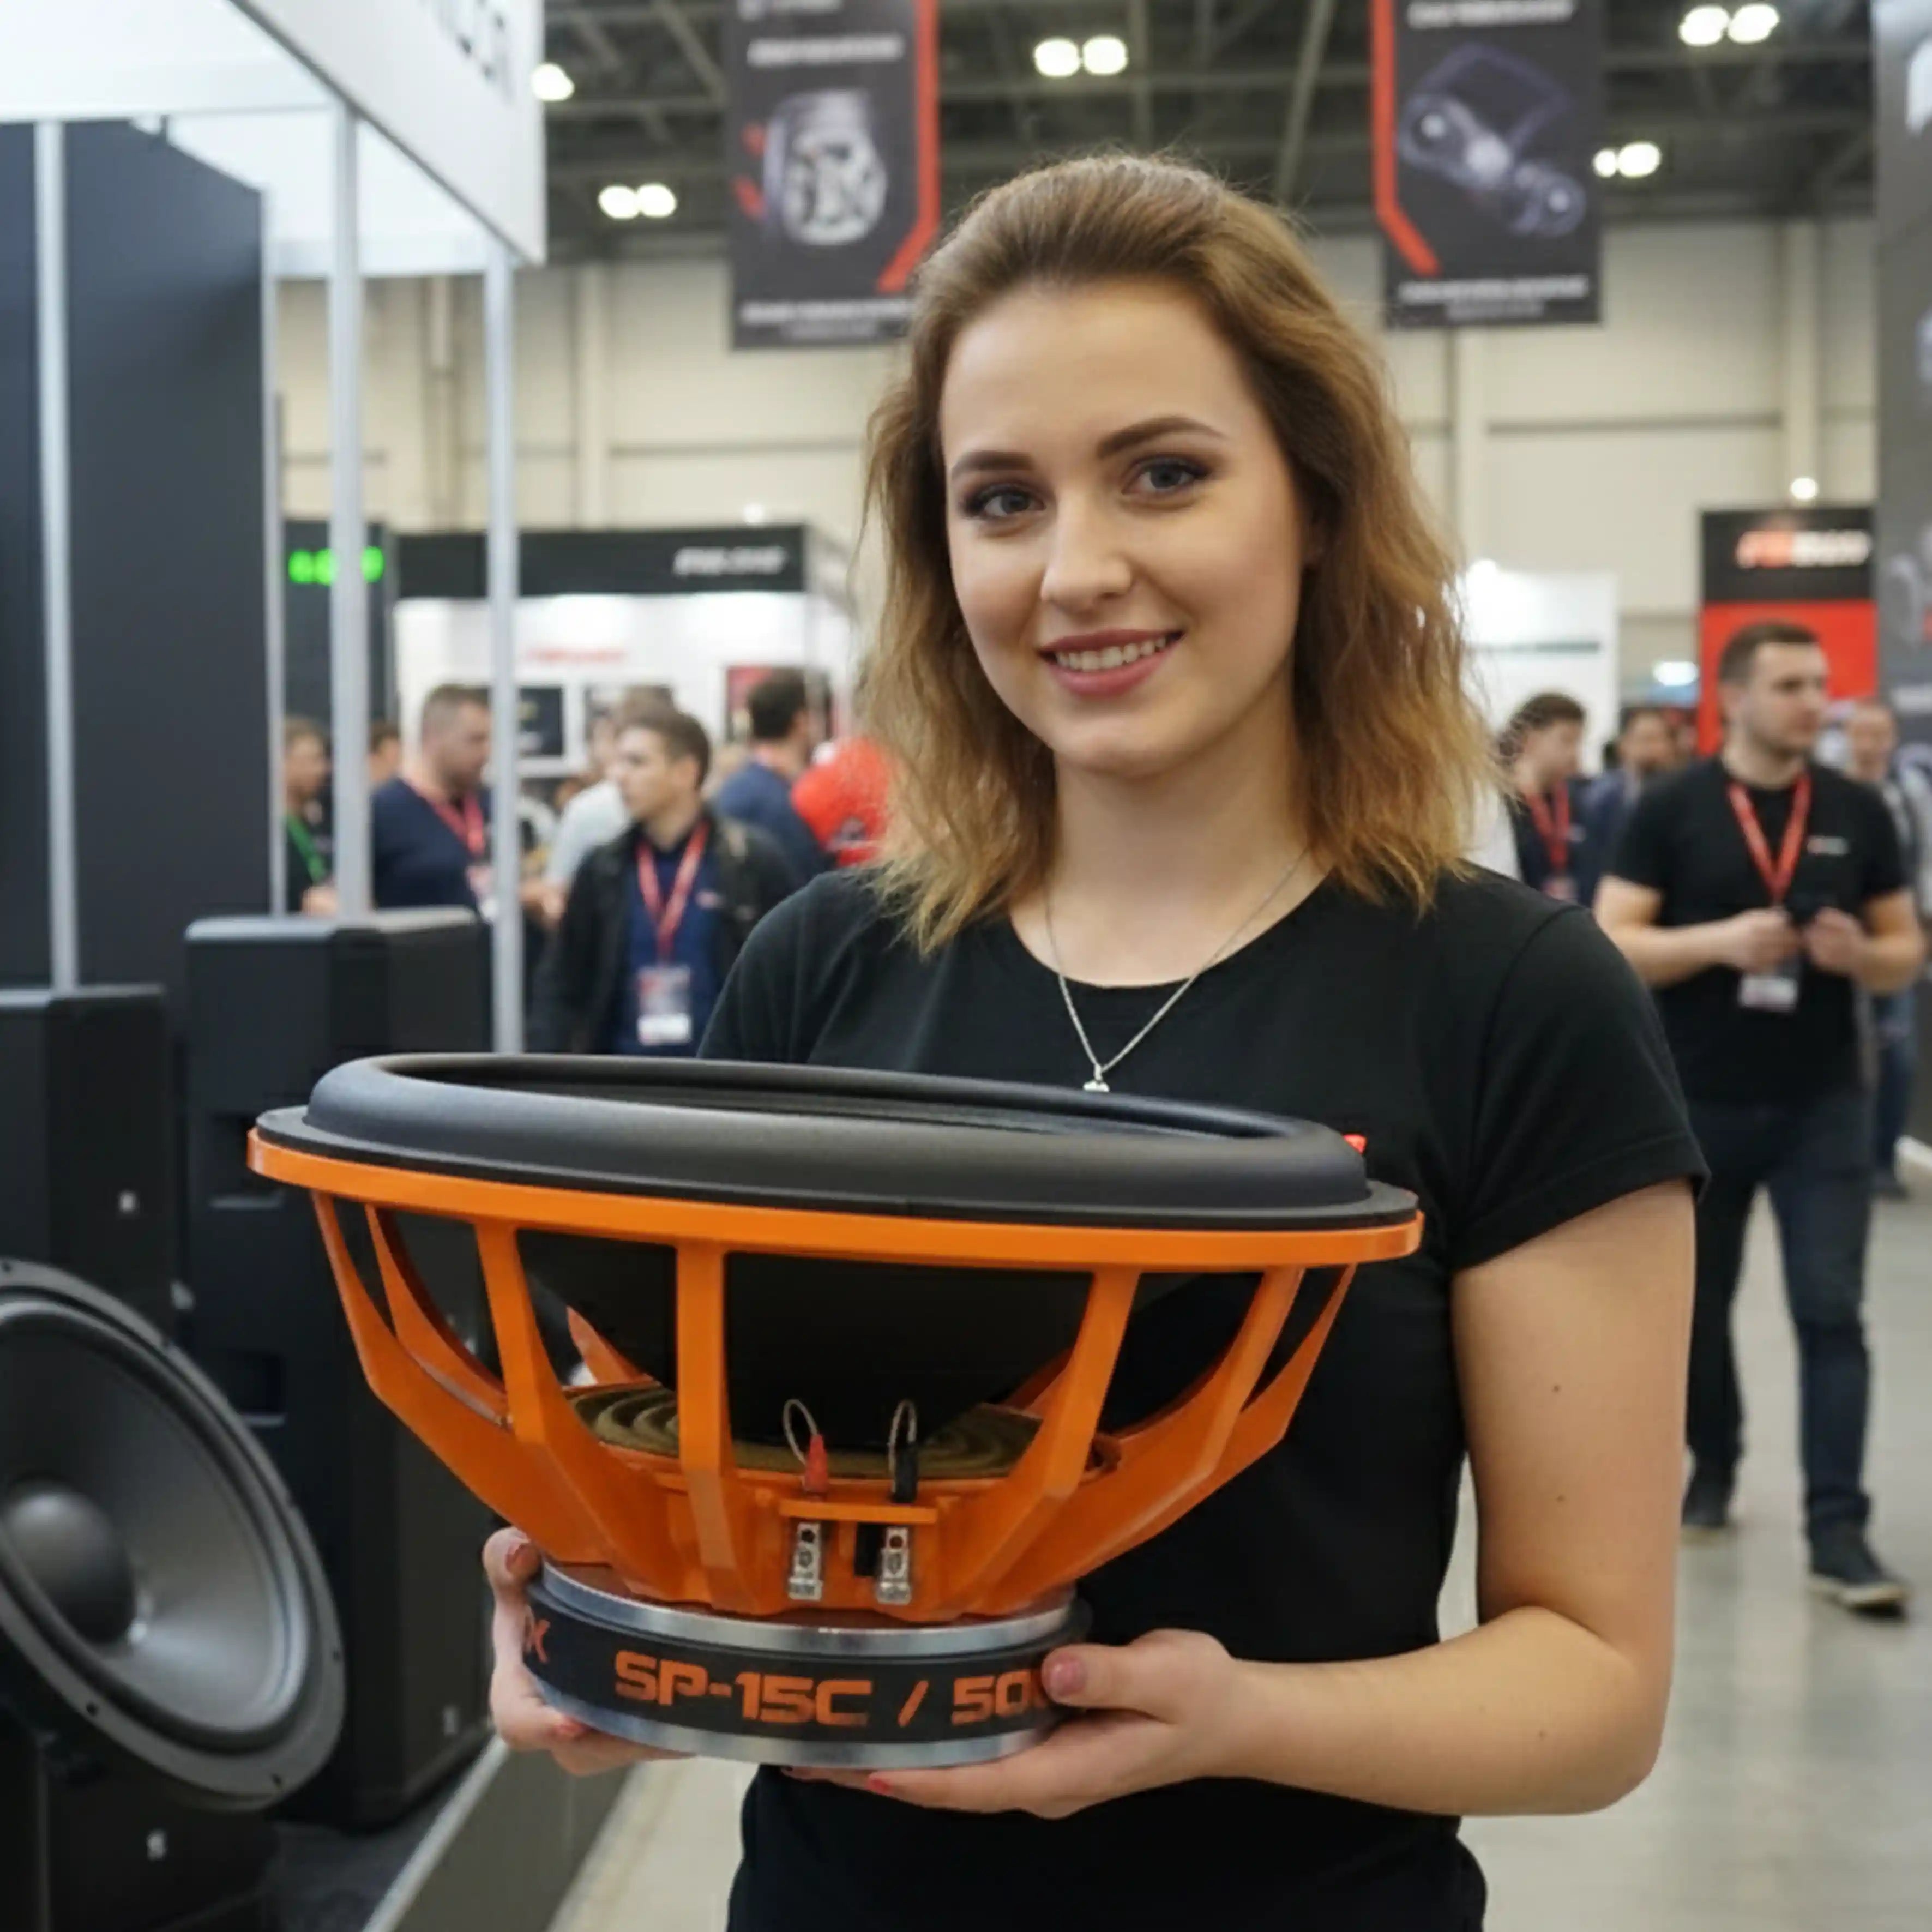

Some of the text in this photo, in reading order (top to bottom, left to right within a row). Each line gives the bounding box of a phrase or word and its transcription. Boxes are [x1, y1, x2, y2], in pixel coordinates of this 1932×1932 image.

[615, 1649, 1046, 1728] SP-15C / 50
